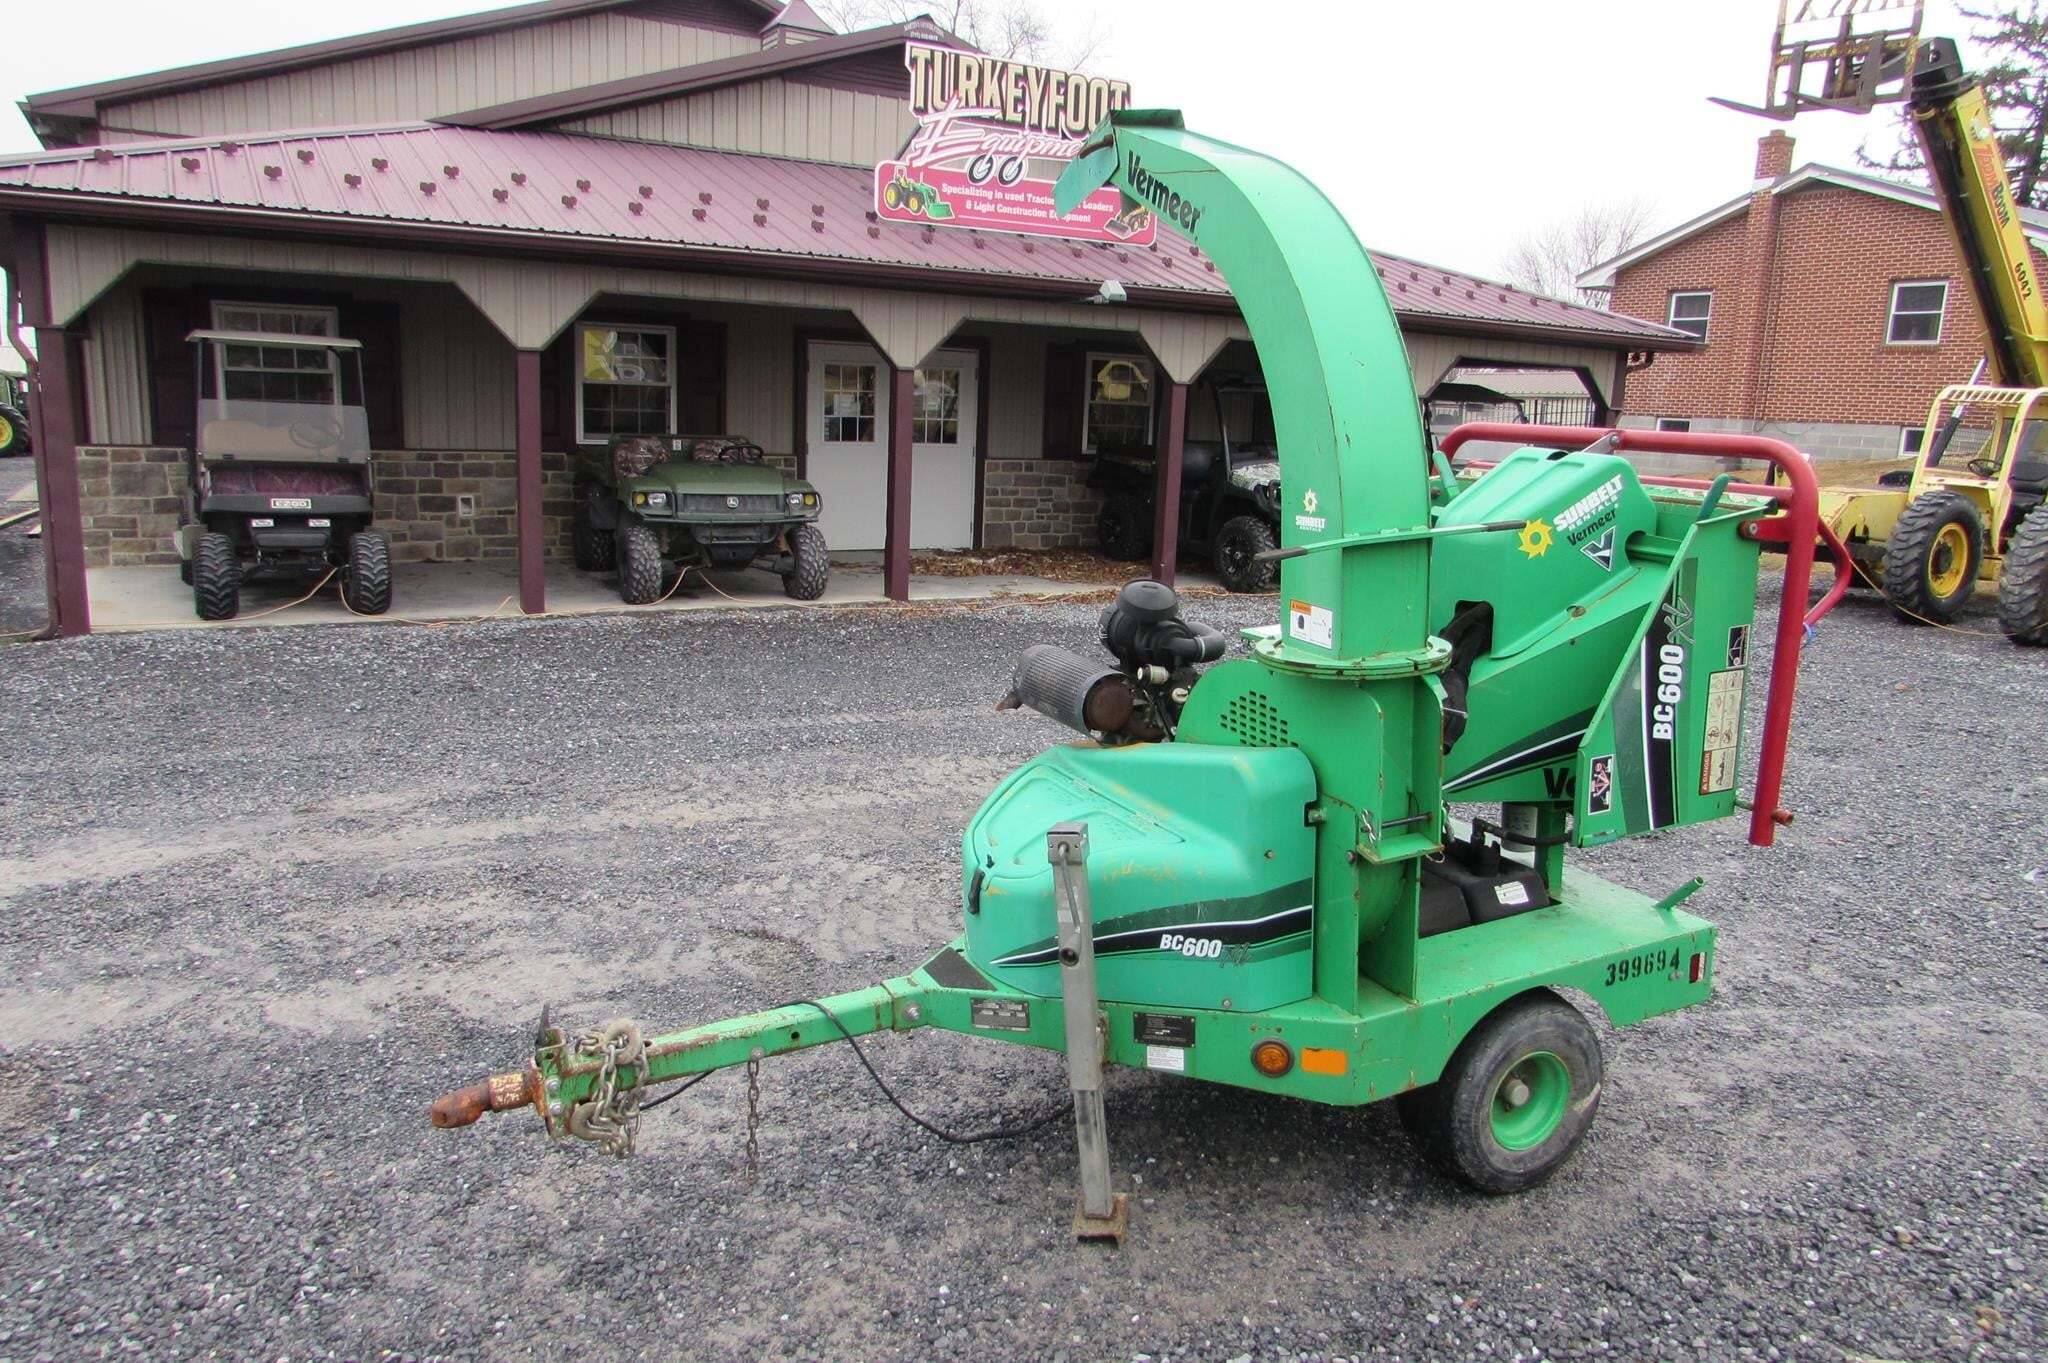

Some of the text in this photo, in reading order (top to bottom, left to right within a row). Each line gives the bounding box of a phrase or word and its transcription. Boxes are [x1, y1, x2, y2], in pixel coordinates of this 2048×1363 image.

[910, 49, 1131, 133] TURKEYFOOT
[912, 96, 1084, 178] Equipme
[942, 183, 993, 200] Specializing
[994, 190, 1004, 200] in
[1005, 191, 1025, 202] used
[1083, 201, 1114, 212] Loaders
[974, 201, 996, 212] Light
[997, 203, 1048, 218] Construction
[1128, 150, 1201, 233] Vermeer
[2014, 262, 2033, 301] 6042
[1296, 515, 1325, 528] SUNBELT
[1552, 474, 1623, 532] SUNBELT
[1568, 494, 1619, 531] RENTALS
[1567, 509, 1616, 546] Vermeer
[1652, 644, 1684, 740] BC600
[1160, 934, 1222, 958] BC600
[1605, 947, 1680, 986] 399694
